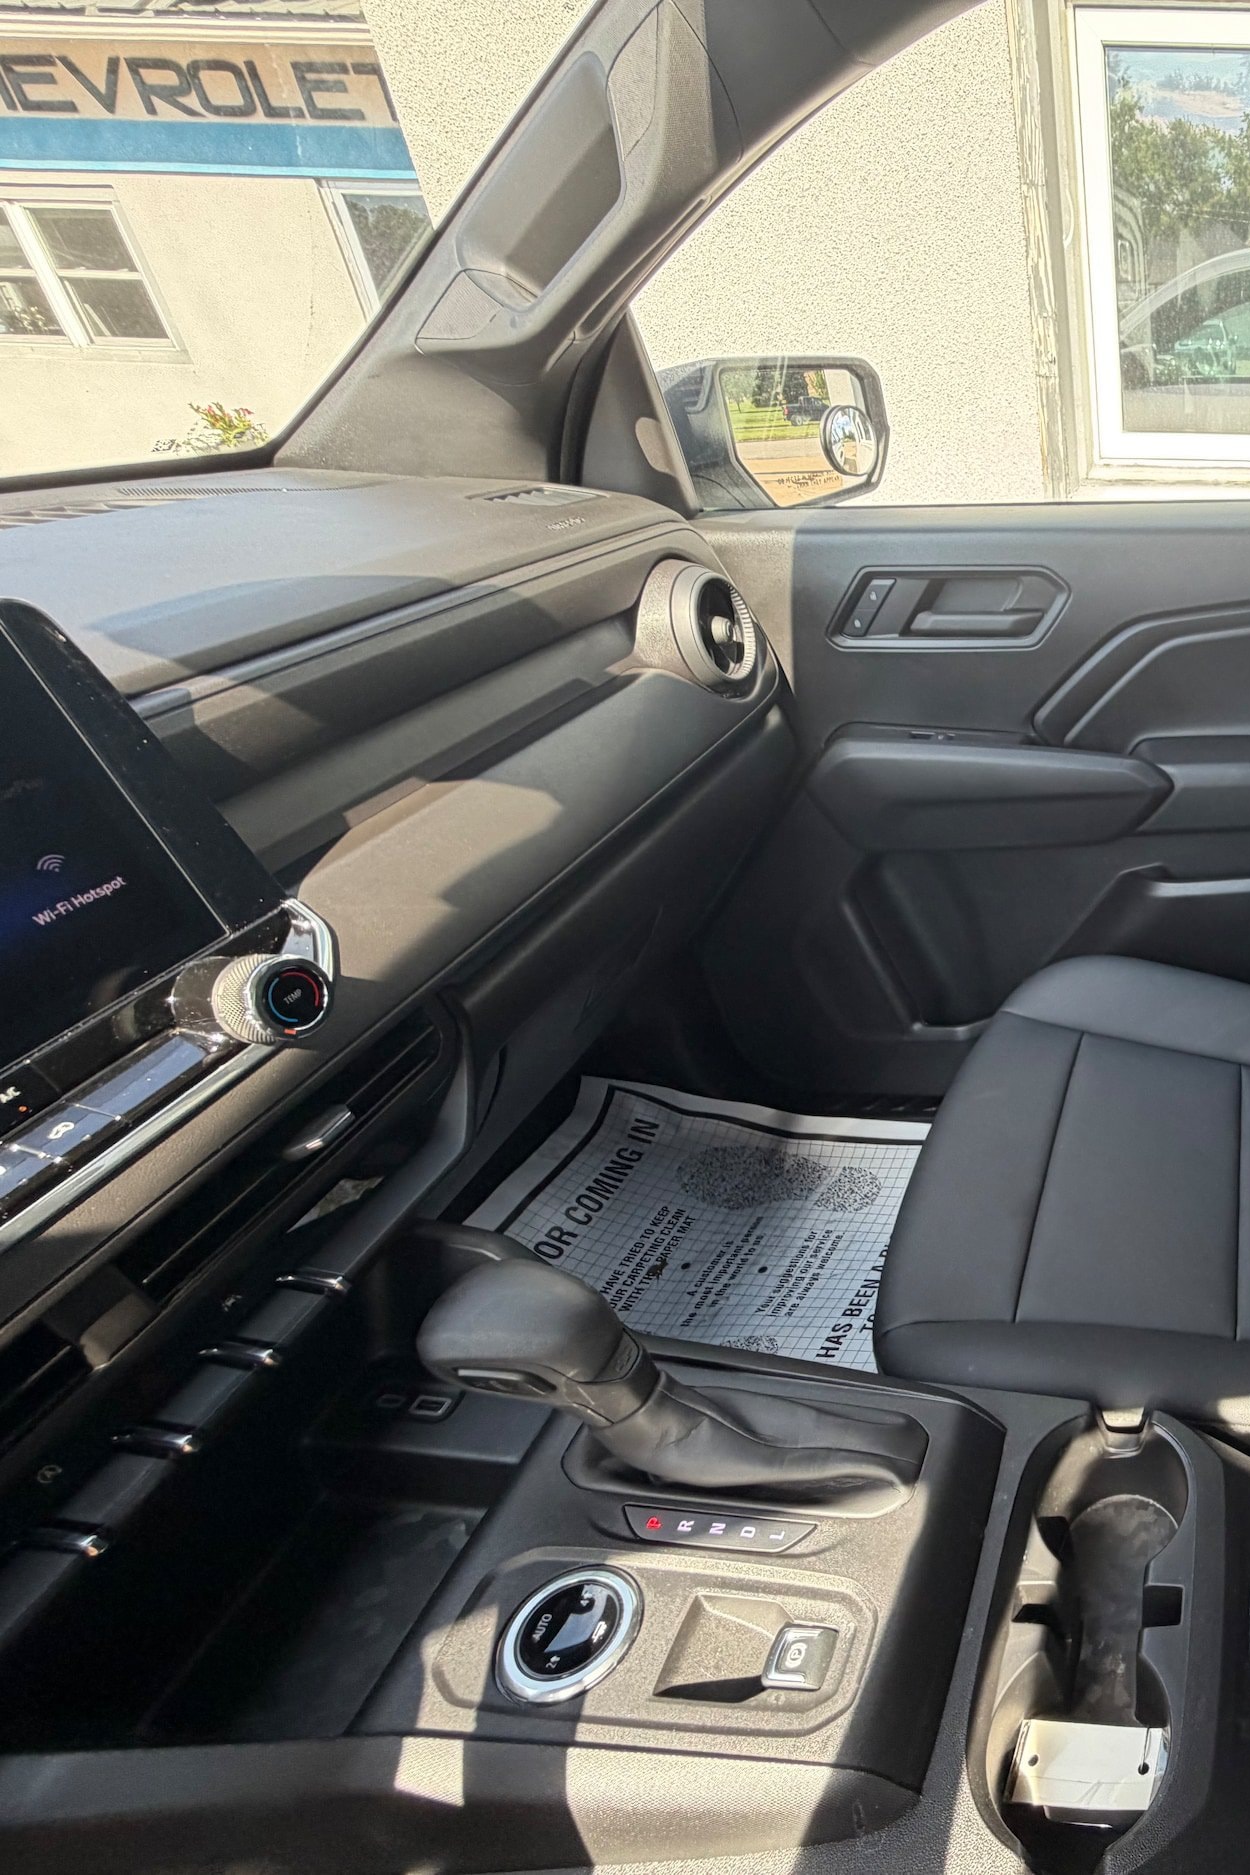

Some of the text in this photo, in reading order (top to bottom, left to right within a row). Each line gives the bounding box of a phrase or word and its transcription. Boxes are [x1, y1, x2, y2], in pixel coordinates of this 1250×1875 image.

[32, 875, 127, 926] Wi-Fi Hotspot
[533, 1118, 660, 1260] OR COMING IN
[600, 1205, 670, 1294] HAVE TRIED TO KEEP
[618, 1286, 645, 1312] WITH
[656, 1235, 682, 1264] PAPER
[677, 1215, 696, 1235] MAT
[622, 1237, 665, 1287] CARPETING
[660, 1208, 686, 1236] CLEAN
[680, 1312, 697, 1326] the
[694, 1286, 714, 1309] most
[708, 1245, 744, 1284] important
[694, 1250, 726, 1288] customer
[715, 1283, 731, 1296] the
[728, 1258, 749, 1280] world
[744, 1247, 756, 1256] to
[754, 1230, 818, 1313] Your suggestions for
[785, 1232, 846, 1317] are always welcome.
[800, 1260, 814, 1274] our
[810, 1229, 833, 1258] service
[815, 1323, 853, 1358] HAS
[841, 1279, 881, 1317] BEEN
[646, 1516, 786, 1540] P R N D L
[531, 1613, 553, 1643] AUTO
